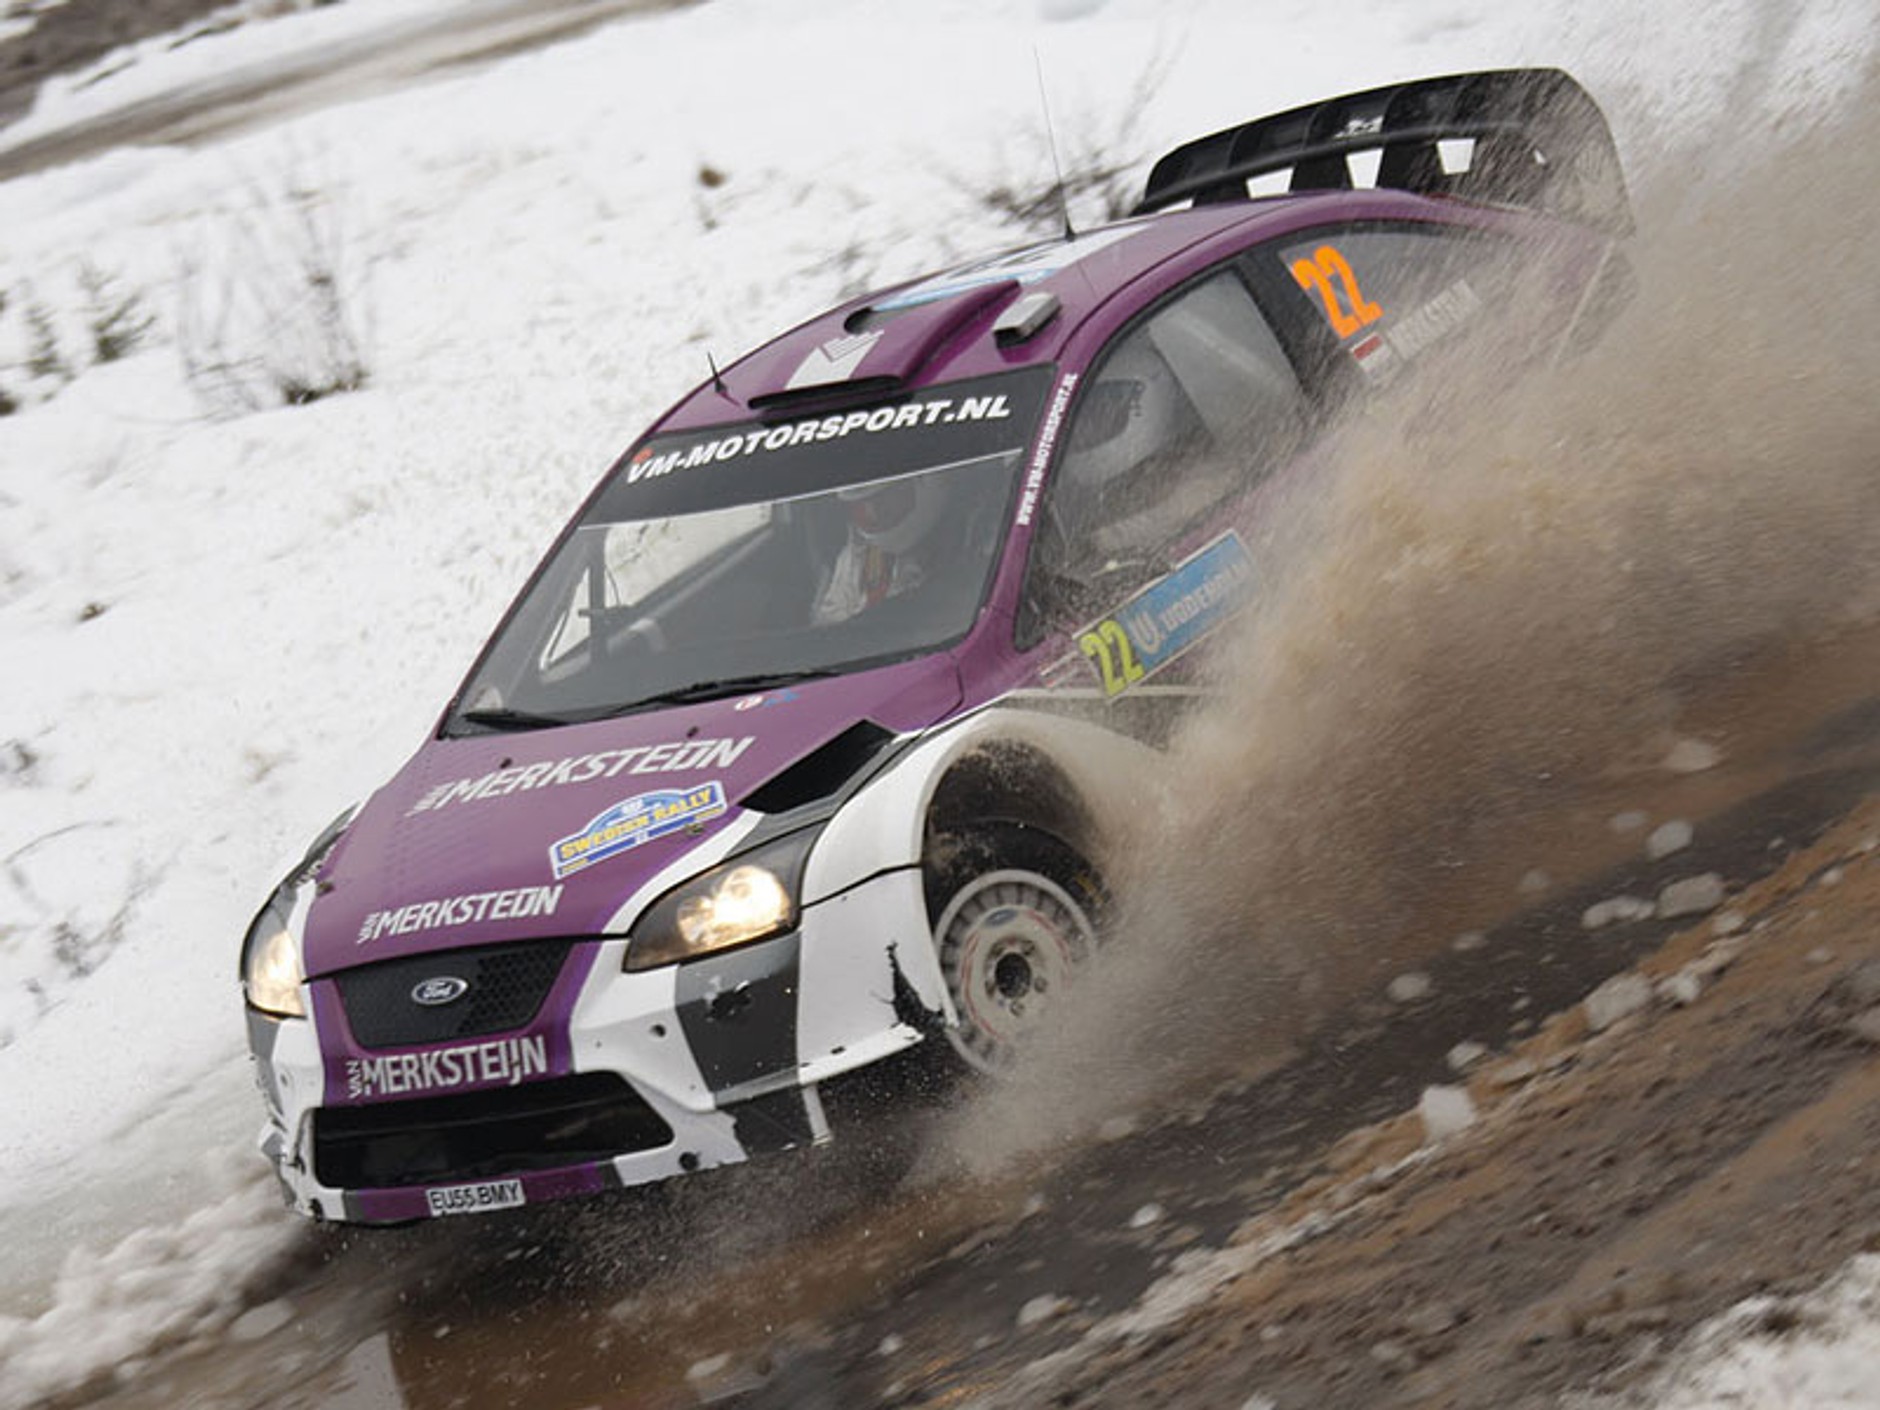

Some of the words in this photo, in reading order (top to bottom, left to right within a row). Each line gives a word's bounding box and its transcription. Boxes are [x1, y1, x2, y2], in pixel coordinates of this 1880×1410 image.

[1291, 246, 1383, 339] 22
[627, 396, 1010, 483] VM-MOTORSPORT.NL
[1080, 620, 1144, 694] 22
[654, 789, 711, 819] RALLY
[372, 886, 563, 940] MERKSTEIJN
[347, 1060, 362, 1098] VAN
[363, 1036, 547, 1096] MERKSTEIJN
[430, 1187, 475, 1209] EU55
[478, 1182, 519, 1204] BMY
